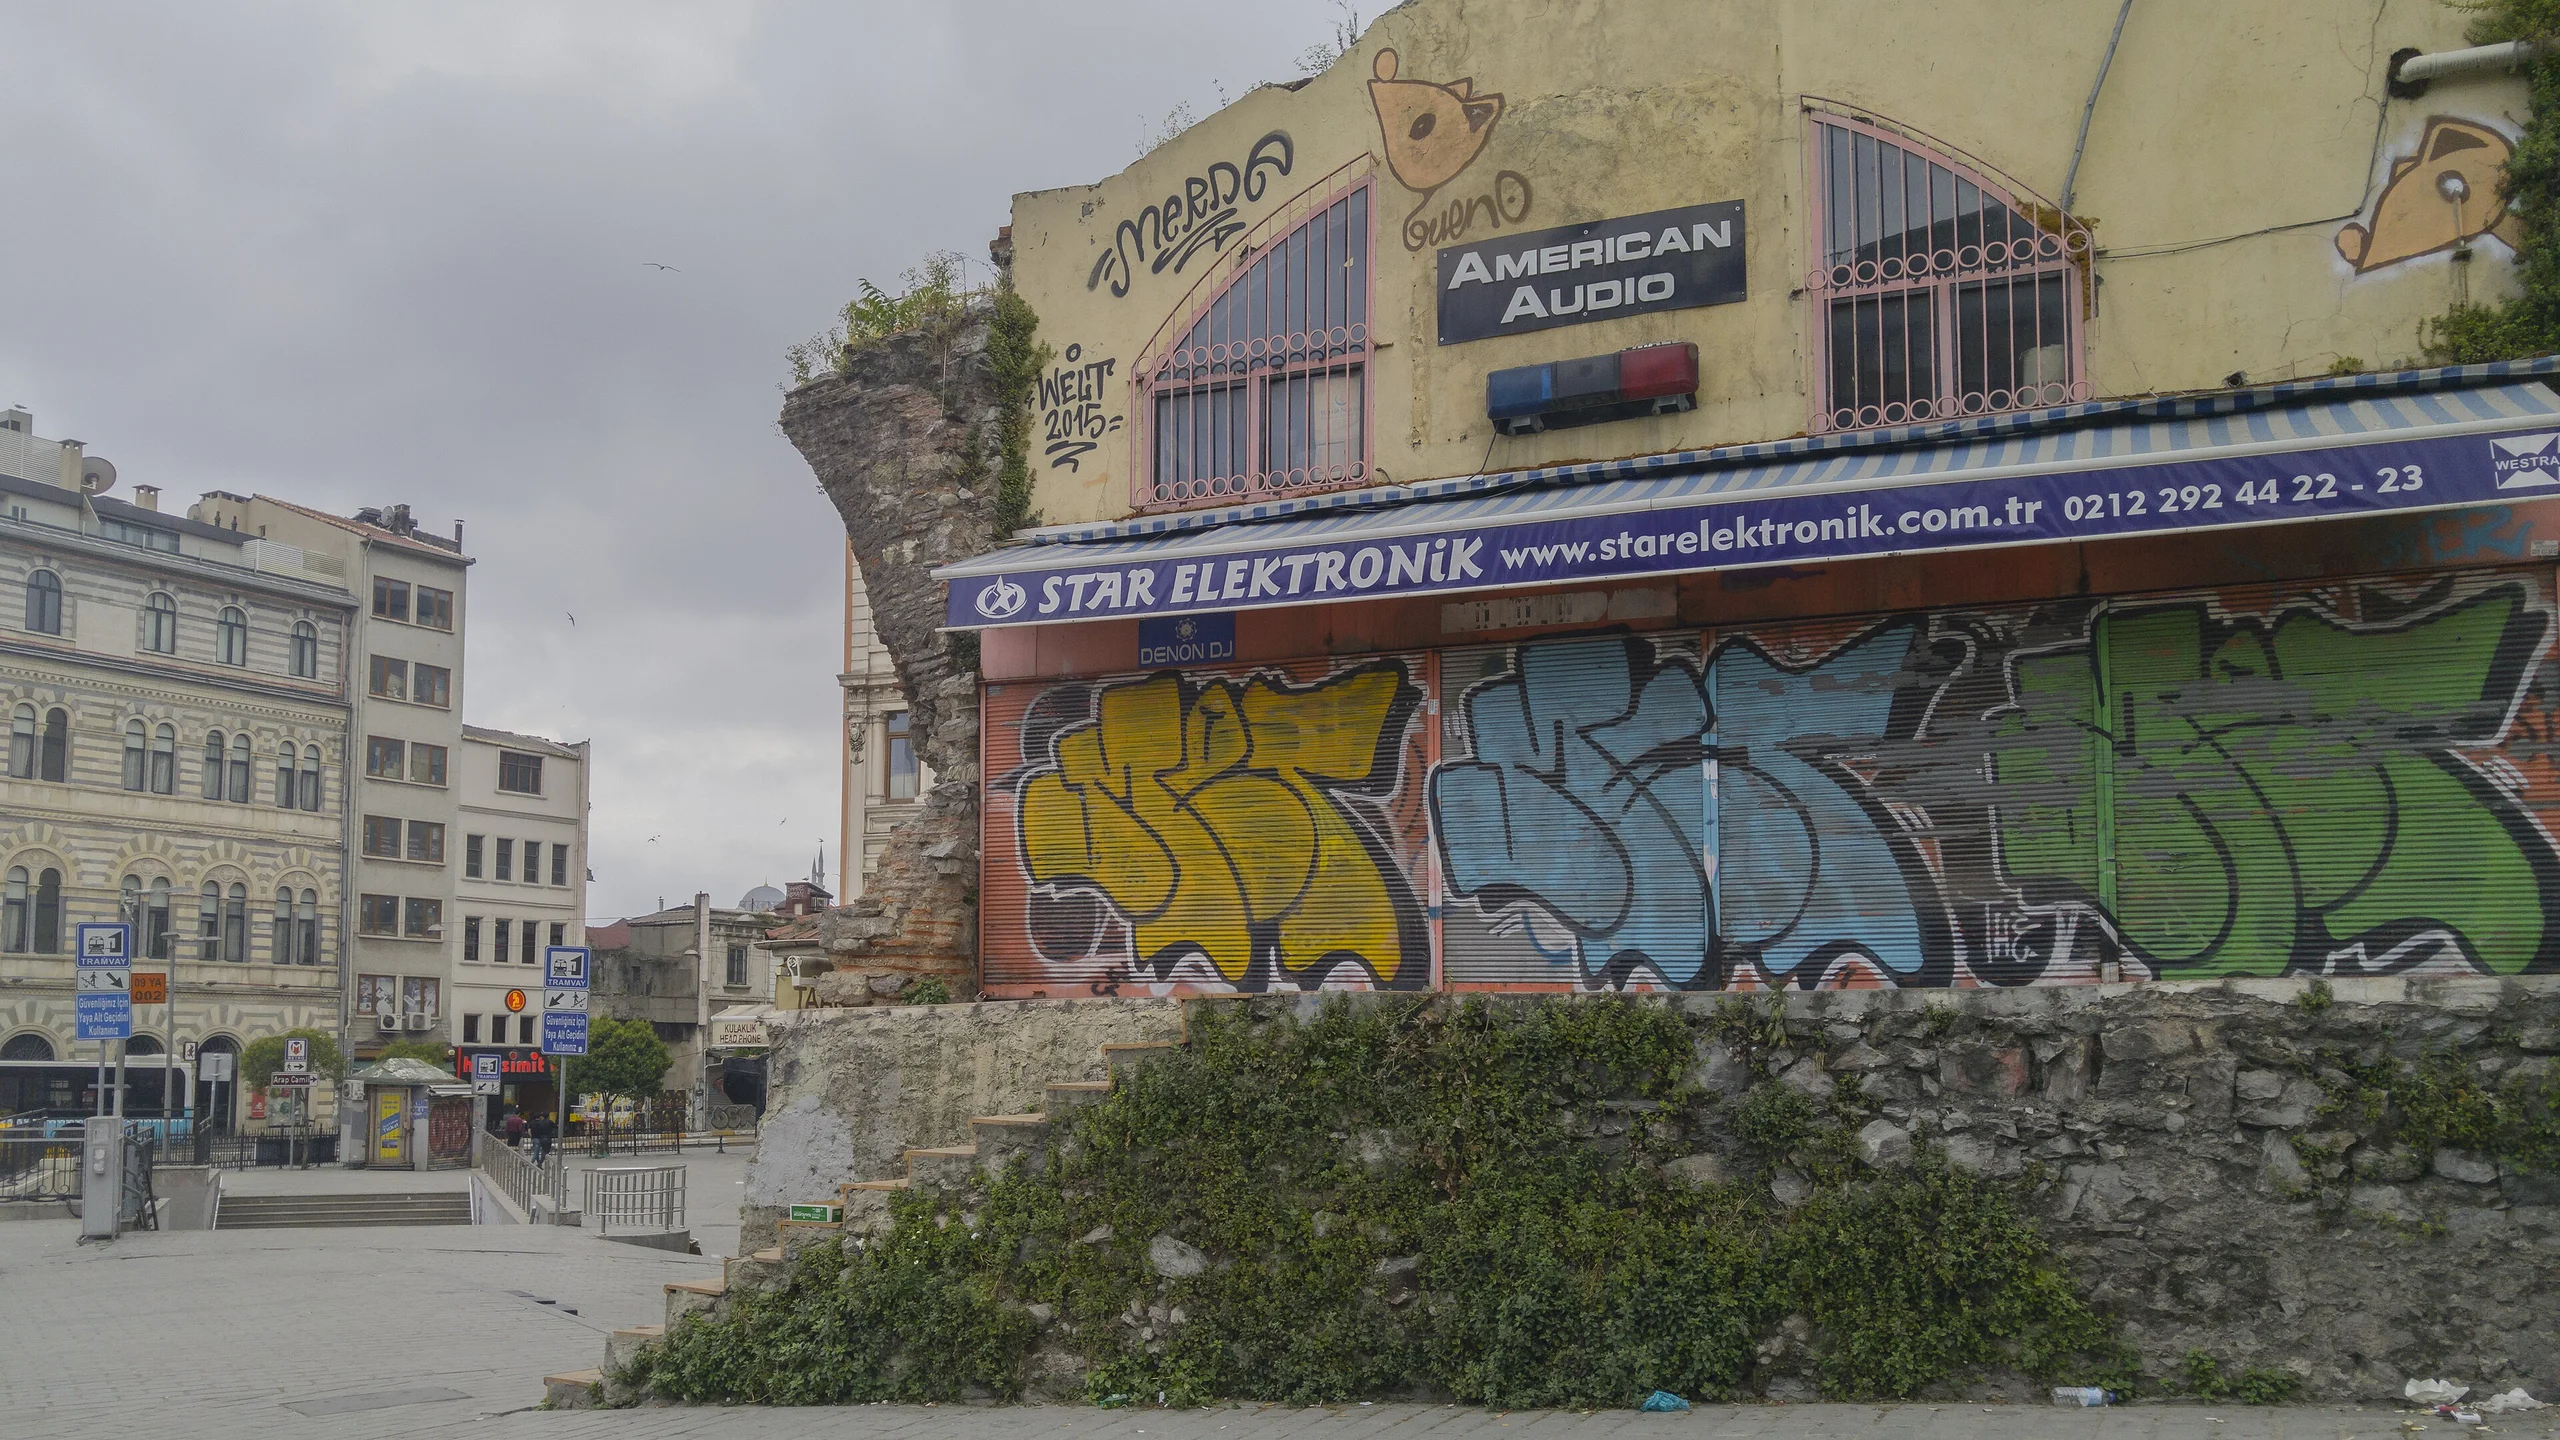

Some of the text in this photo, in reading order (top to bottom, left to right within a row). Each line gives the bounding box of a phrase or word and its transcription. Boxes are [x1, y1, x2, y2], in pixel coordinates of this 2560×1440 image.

[1447, 219, 1731, 290] AMERICAN
[1500, 271, 1675, 324] AUDIO
[1044, 403, 1107, 441] 2015
[2495, 455, 2560, 471] WESTRA
[1038, 568, 1156, 614] STAR
[1500, 495, 2042, 570] www.starelektronik.com.tr
[2064, 490, 2146, 523] 0212
[2158, 484, 2223, 514] 292
[2235, 478, 2280, 506] 44
[2292, 473, 2338, 502] 22
[2376, 464, 2424, 494] 23
[1140, 640, 1233, 665] DENON DJ
[80, 957, 127, 966] TRAMVAY
[134, 978, 162, 987] 09 YA
[547, 978, 587, 987] TRAMVAY
[135, 990, 162, 1001] 002
[78, 1012, 93, 1025] Yaya
[94, 1012, 103, 1022] Alt
[544, 1028, 557, 1040] Yaya
[557, 1029, 566, 1040] Alt
[724, 1023, 757, 1034] KULAKLIK
[720, 1034, 761, 1044] HEAD PHONE
[273, 1075, 290, 1084] Arap
